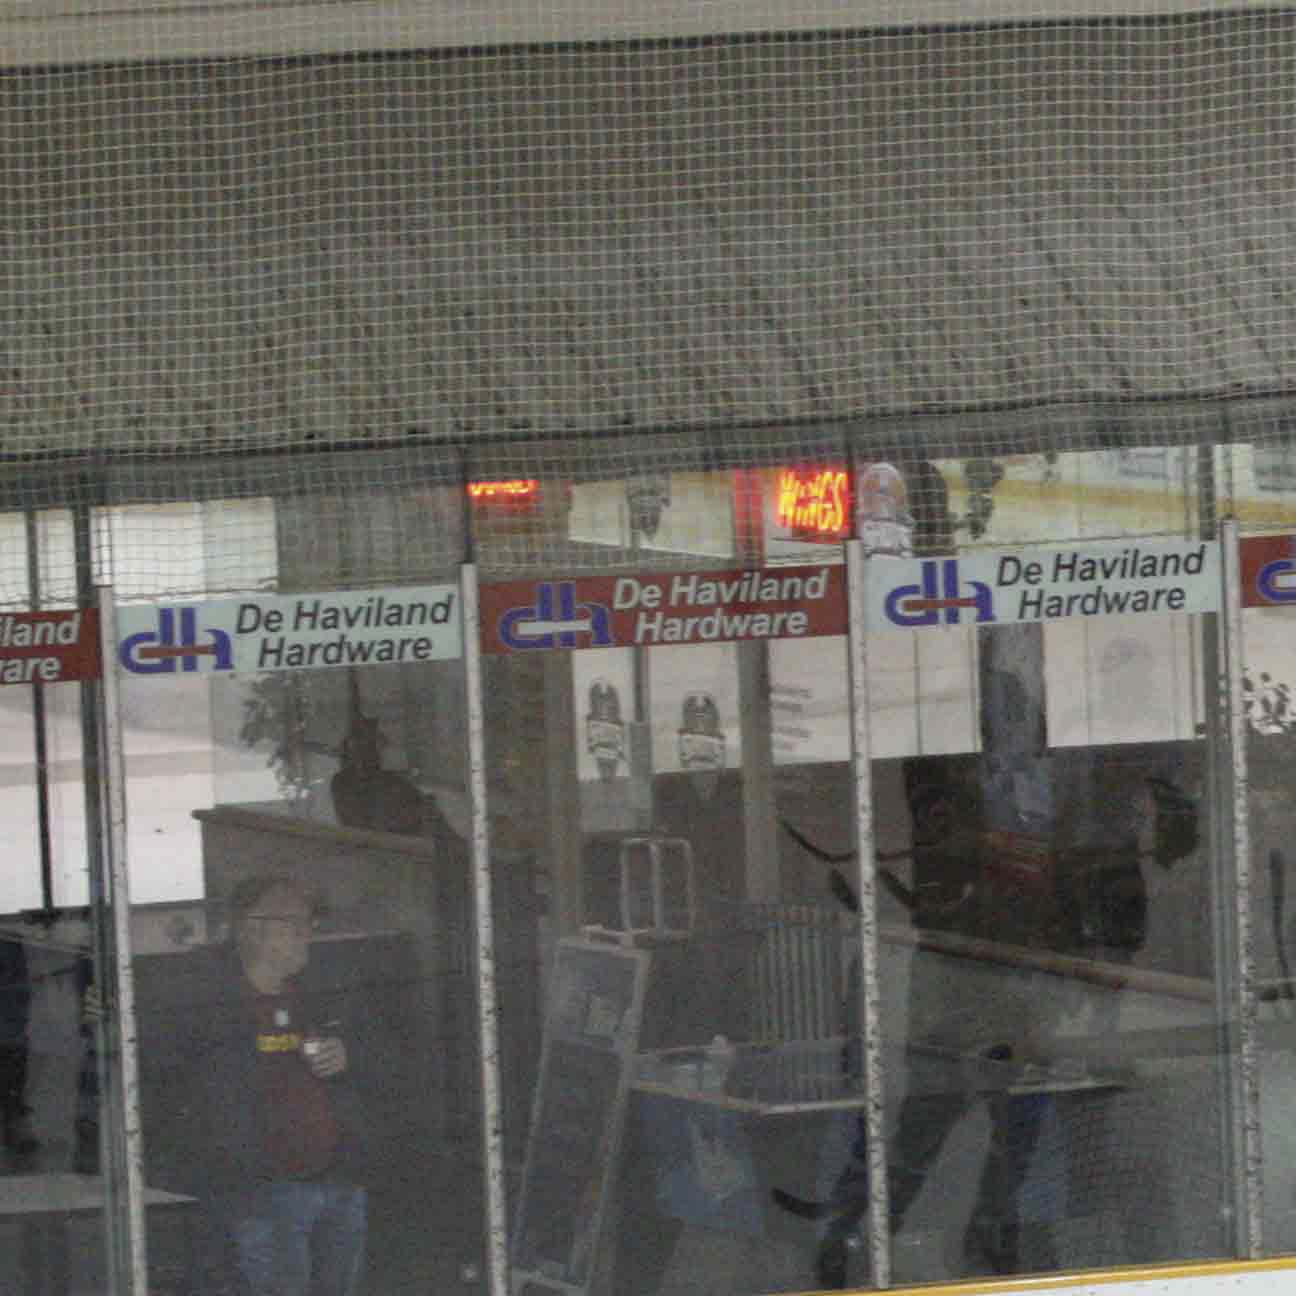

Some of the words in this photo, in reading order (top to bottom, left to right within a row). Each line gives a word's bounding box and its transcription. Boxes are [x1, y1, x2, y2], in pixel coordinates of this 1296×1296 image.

[997, 556, 1041, 586] De
[1051, 545, 1205, 582] Haviland
[614, 578, 661, 608] De
[669, 569, 828, 606] Haviland
[1018, 586, 1186, 619] Hardware
[0, 613, 81, 648] land
[236, 604, 282, 634] De
[294, 594, 454, 631] Haviland
[635, 608, 808, 643] Hardware
[258, 635, 432, 667] Hardware
